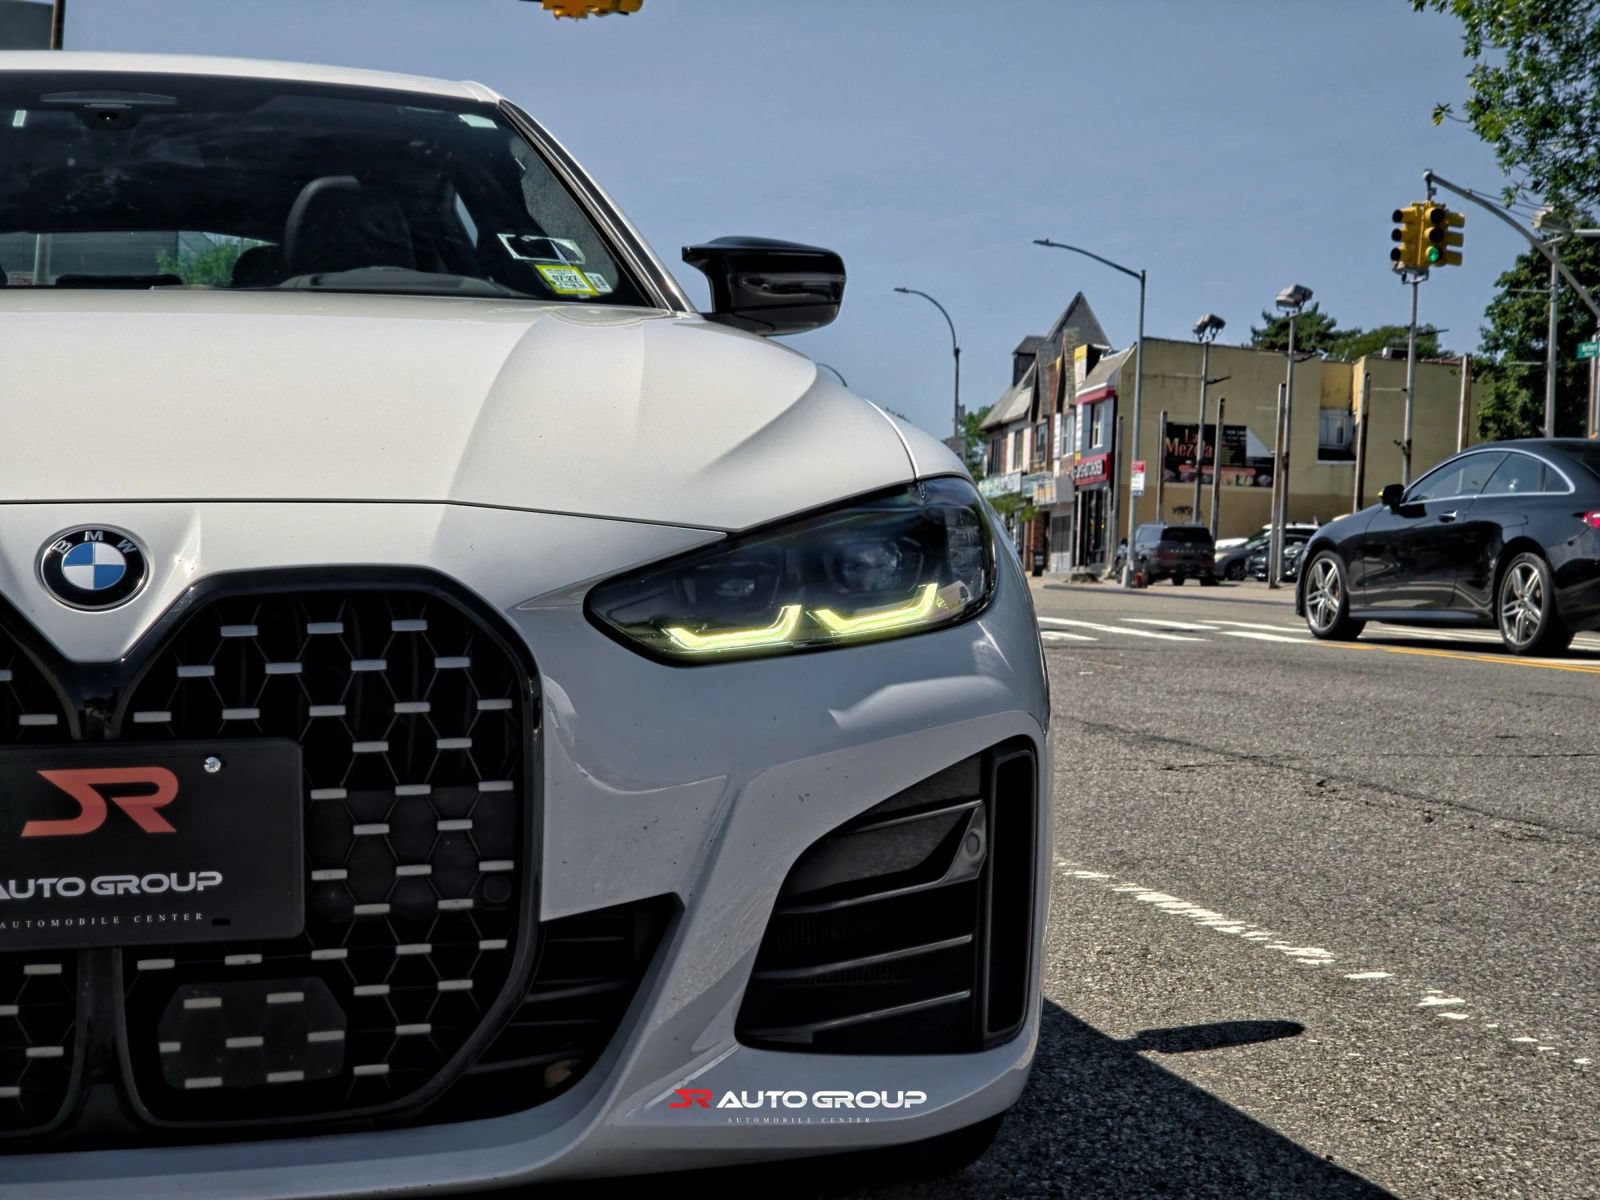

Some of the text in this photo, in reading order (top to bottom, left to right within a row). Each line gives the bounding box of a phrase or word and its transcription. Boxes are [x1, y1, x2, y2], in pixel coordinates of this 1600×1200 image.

[51, 531, 137, 554] BMW
[20, 766, 179, 837] SR
[90, 871, 223, 895] GROUP
[0, 912, 204, 929] AUTOMOBILE CENTER
